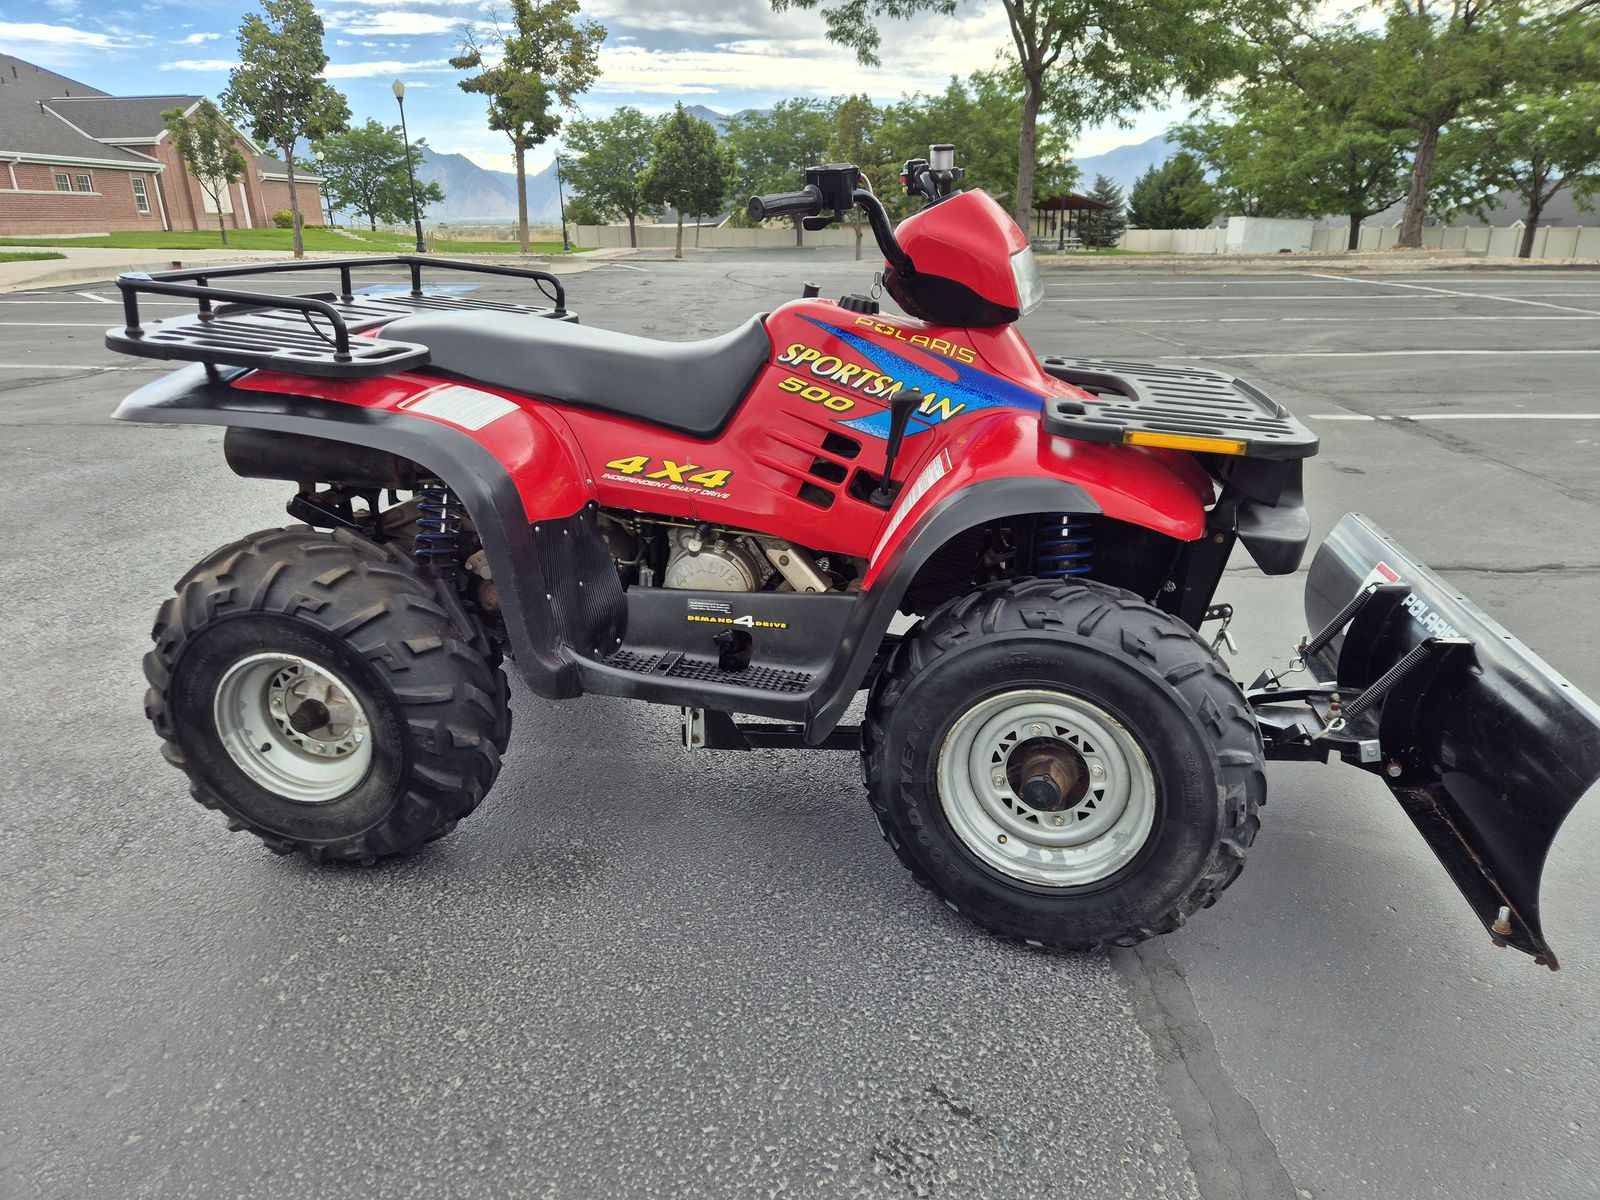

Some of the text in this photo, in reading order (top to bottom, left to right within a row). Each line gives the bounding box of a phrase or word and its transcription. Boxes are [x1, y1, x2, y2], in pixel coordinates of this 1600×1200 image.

[854, 316, 977, 364] POLARIS
[778, 377, 855, 412] 500
[602, 472, 669, 489] INDEPENDENT
[701, 489, 732, 499] DRIVE
[605, 455, 733, 489] 4X4
[687, 615, 787, 629] DEMAND 4 DRIVE
